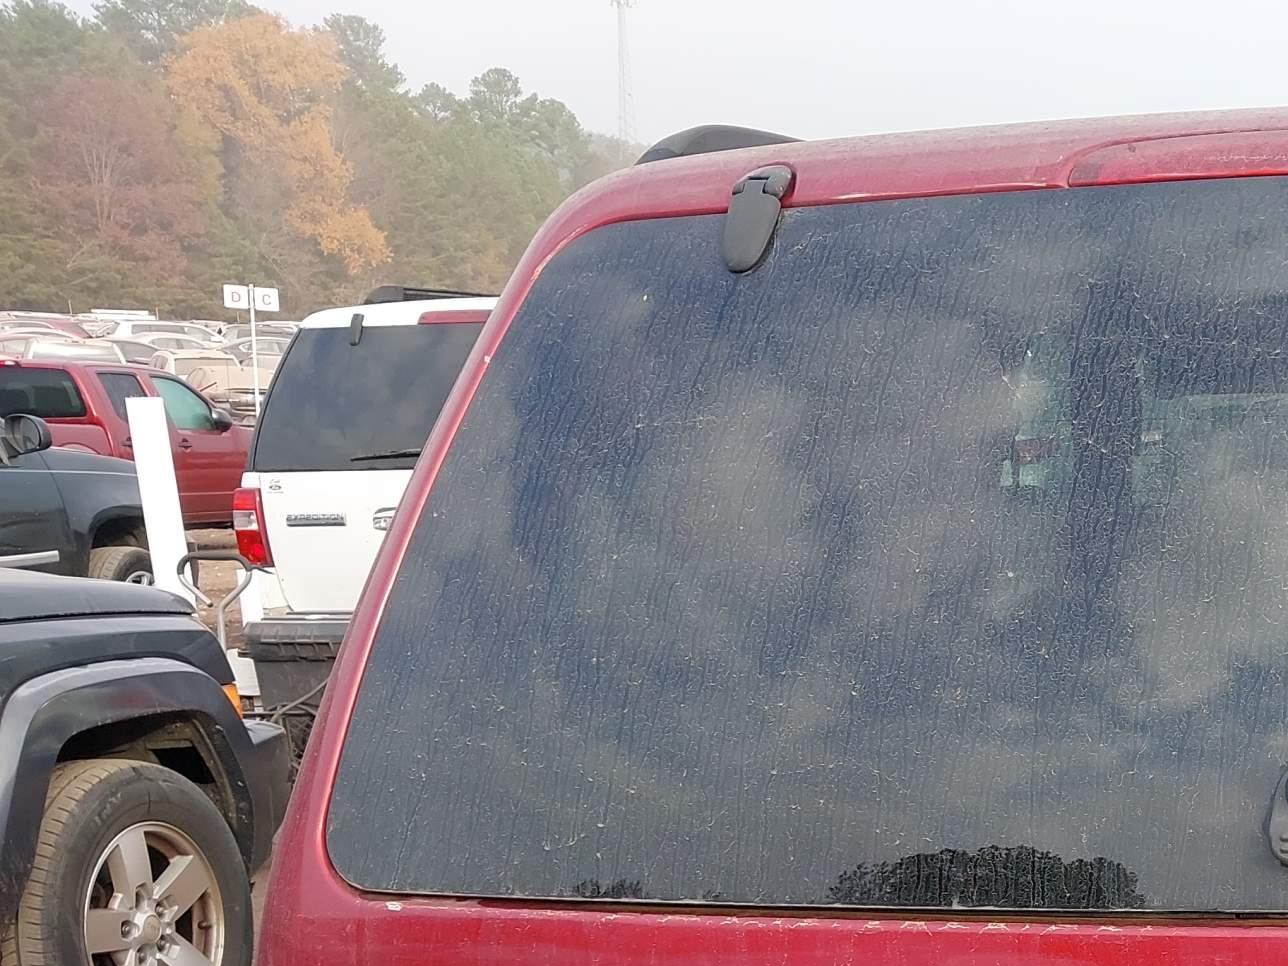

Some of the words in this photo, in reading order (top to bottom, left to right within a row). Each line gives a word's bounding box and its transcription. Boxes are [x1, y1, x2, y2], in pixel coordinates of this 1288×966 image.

[231, 291, 241, 303] D
[262, 294, 272, 306] C
[286, 513, 346, 526] EXPEDITION
